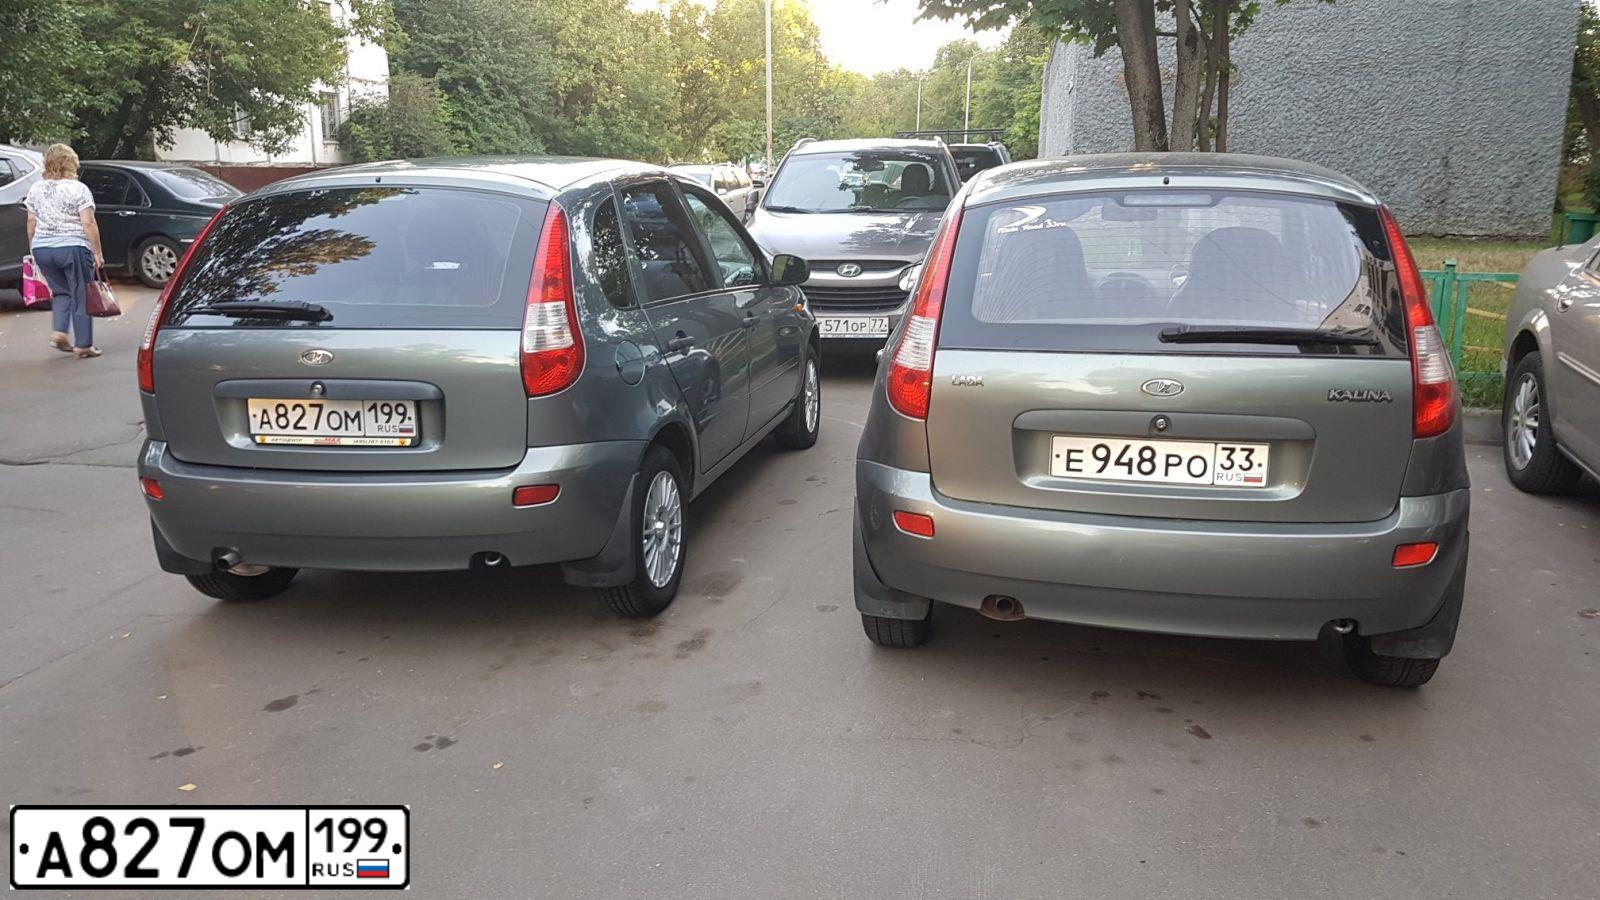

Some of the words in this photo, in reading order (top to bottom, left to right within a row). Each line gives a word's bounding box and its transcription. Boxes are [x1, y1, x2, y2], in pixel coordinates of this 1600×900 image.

[951, 375, 984, 387] LADA
[1327, 388, 1393, 403] KALINA
[367, 402, 409, 424] 199
[377, 425, 399, 433] RUS
[1219, 446, 1255, 471] 33
[1216, 472, 1242, 482] RUS
